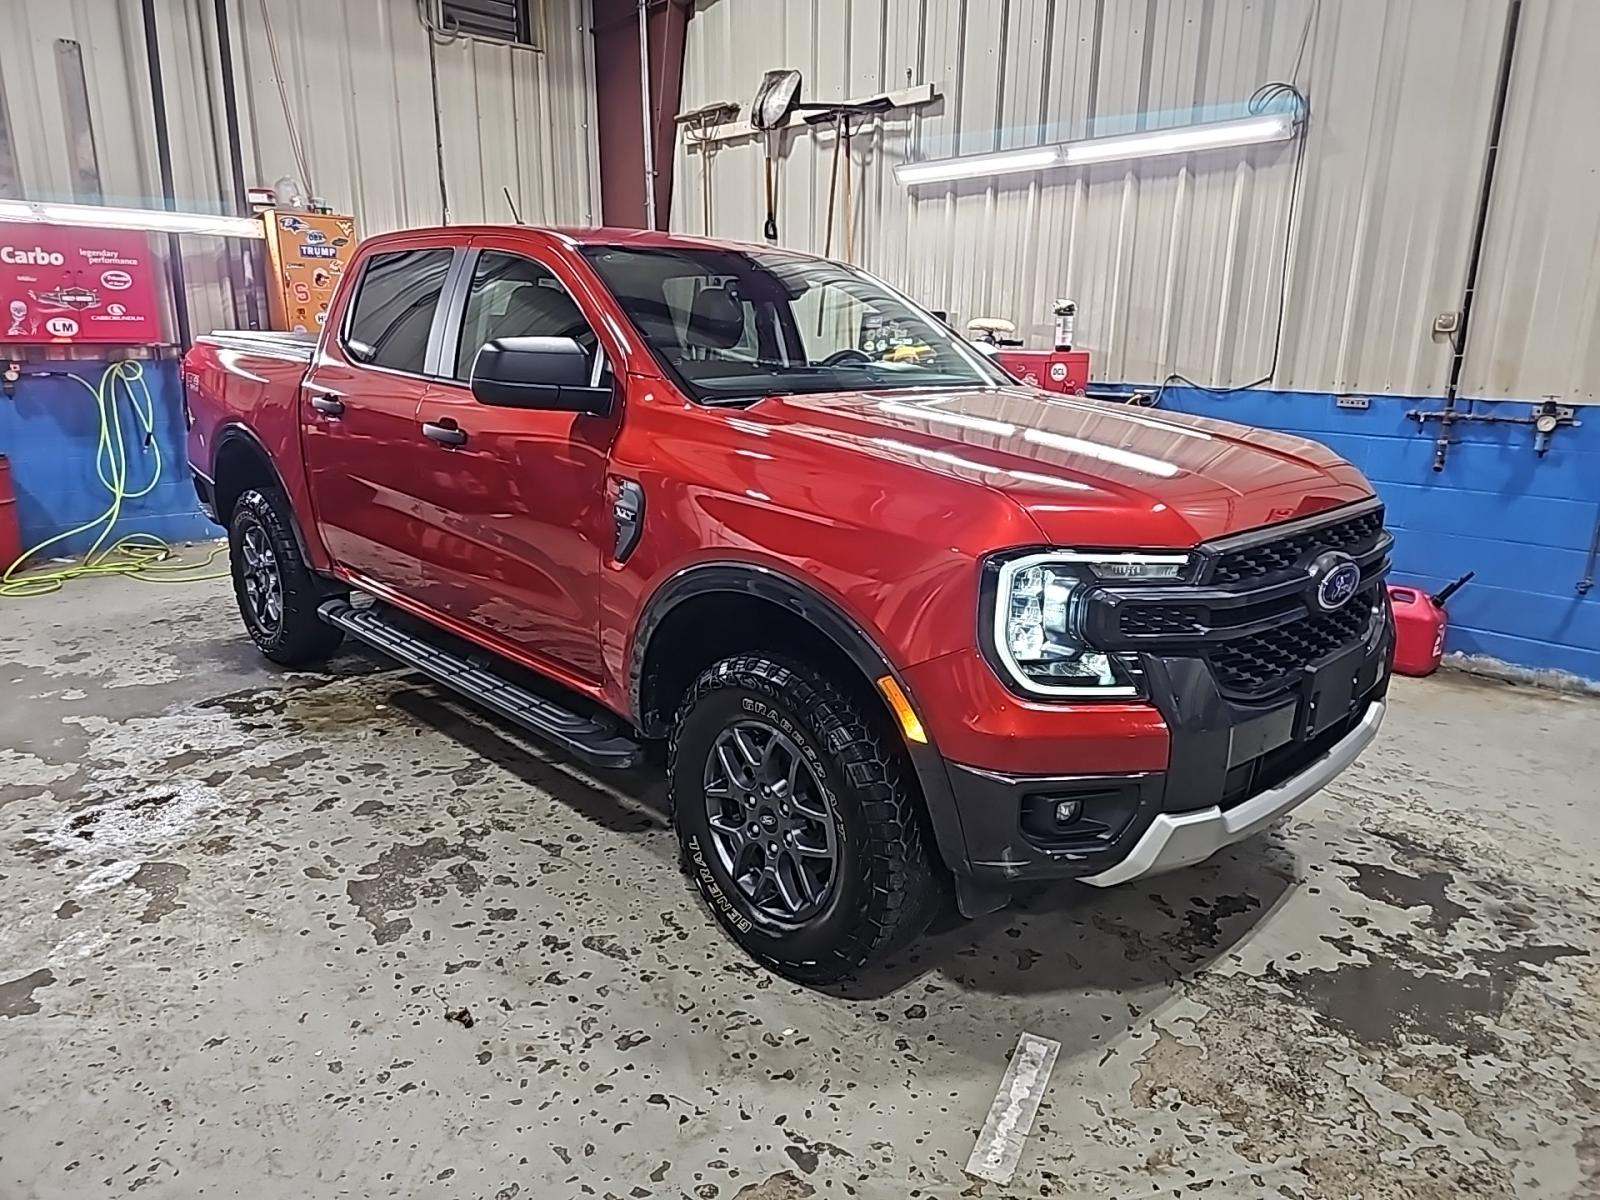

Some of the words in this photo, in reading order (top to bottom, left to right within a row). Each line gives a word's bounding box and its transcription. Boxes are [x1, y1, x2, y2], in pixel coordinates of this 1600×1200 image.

[0, 246, 64, 266] Carbo
[79, 248, 118, 260] legendary
[301, 246, 336, 257] TRUMP
[88, 256, 139, 266] performance
[53, 322, 74, 333] LM
[742, 697, 826, 779] GRABBER
[688, 834, 753, 934] GENERAL
